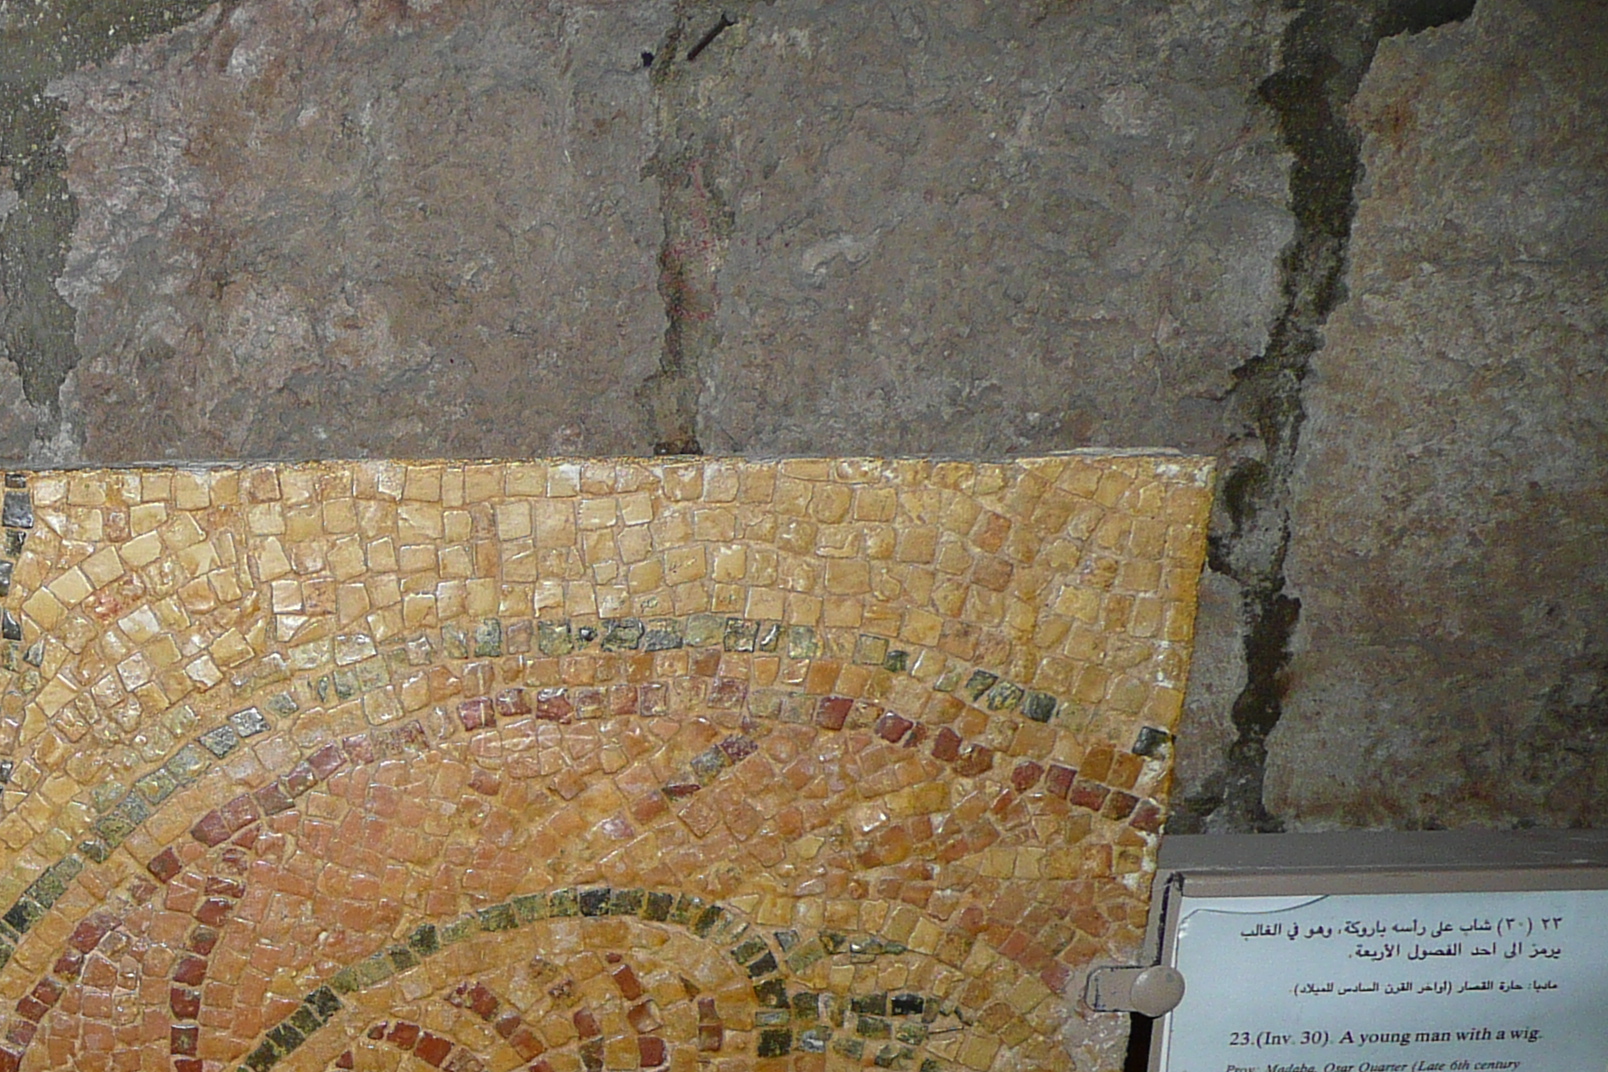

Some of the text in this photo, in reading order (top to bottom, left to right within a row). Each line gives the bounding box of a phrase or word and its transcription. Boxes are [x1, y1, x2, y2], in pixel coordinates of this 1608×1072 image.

[1240, 924, 1281, 939] الغالب
[1287, 923, 1299, 941] في
[1304, 924, 1332, 939] وهو
[1430, 920, 1453, 939] على
[1459, 920, 1492, 937] شاب
[1407, 941, 1461, 960] الفصول
[1529, 942, 1562, 959] يرمز
[1338, 981, 1379, 995] السادس
[1384, 981, 1413, 995] القرن
[1499, 980, 1523, 992] حارة
[1338, 1031, 1355, 1044] A
[1357, 1032, 1411, 1047] young
[1415, 1031, 1451, 1043] man
[1456, 1027, 1492, 1041] with
[1496, 1030, 1505, 1040] a
[1449, 1058, 1471, 1071] 6th
[1473, 1058, 1521, 1072] century
